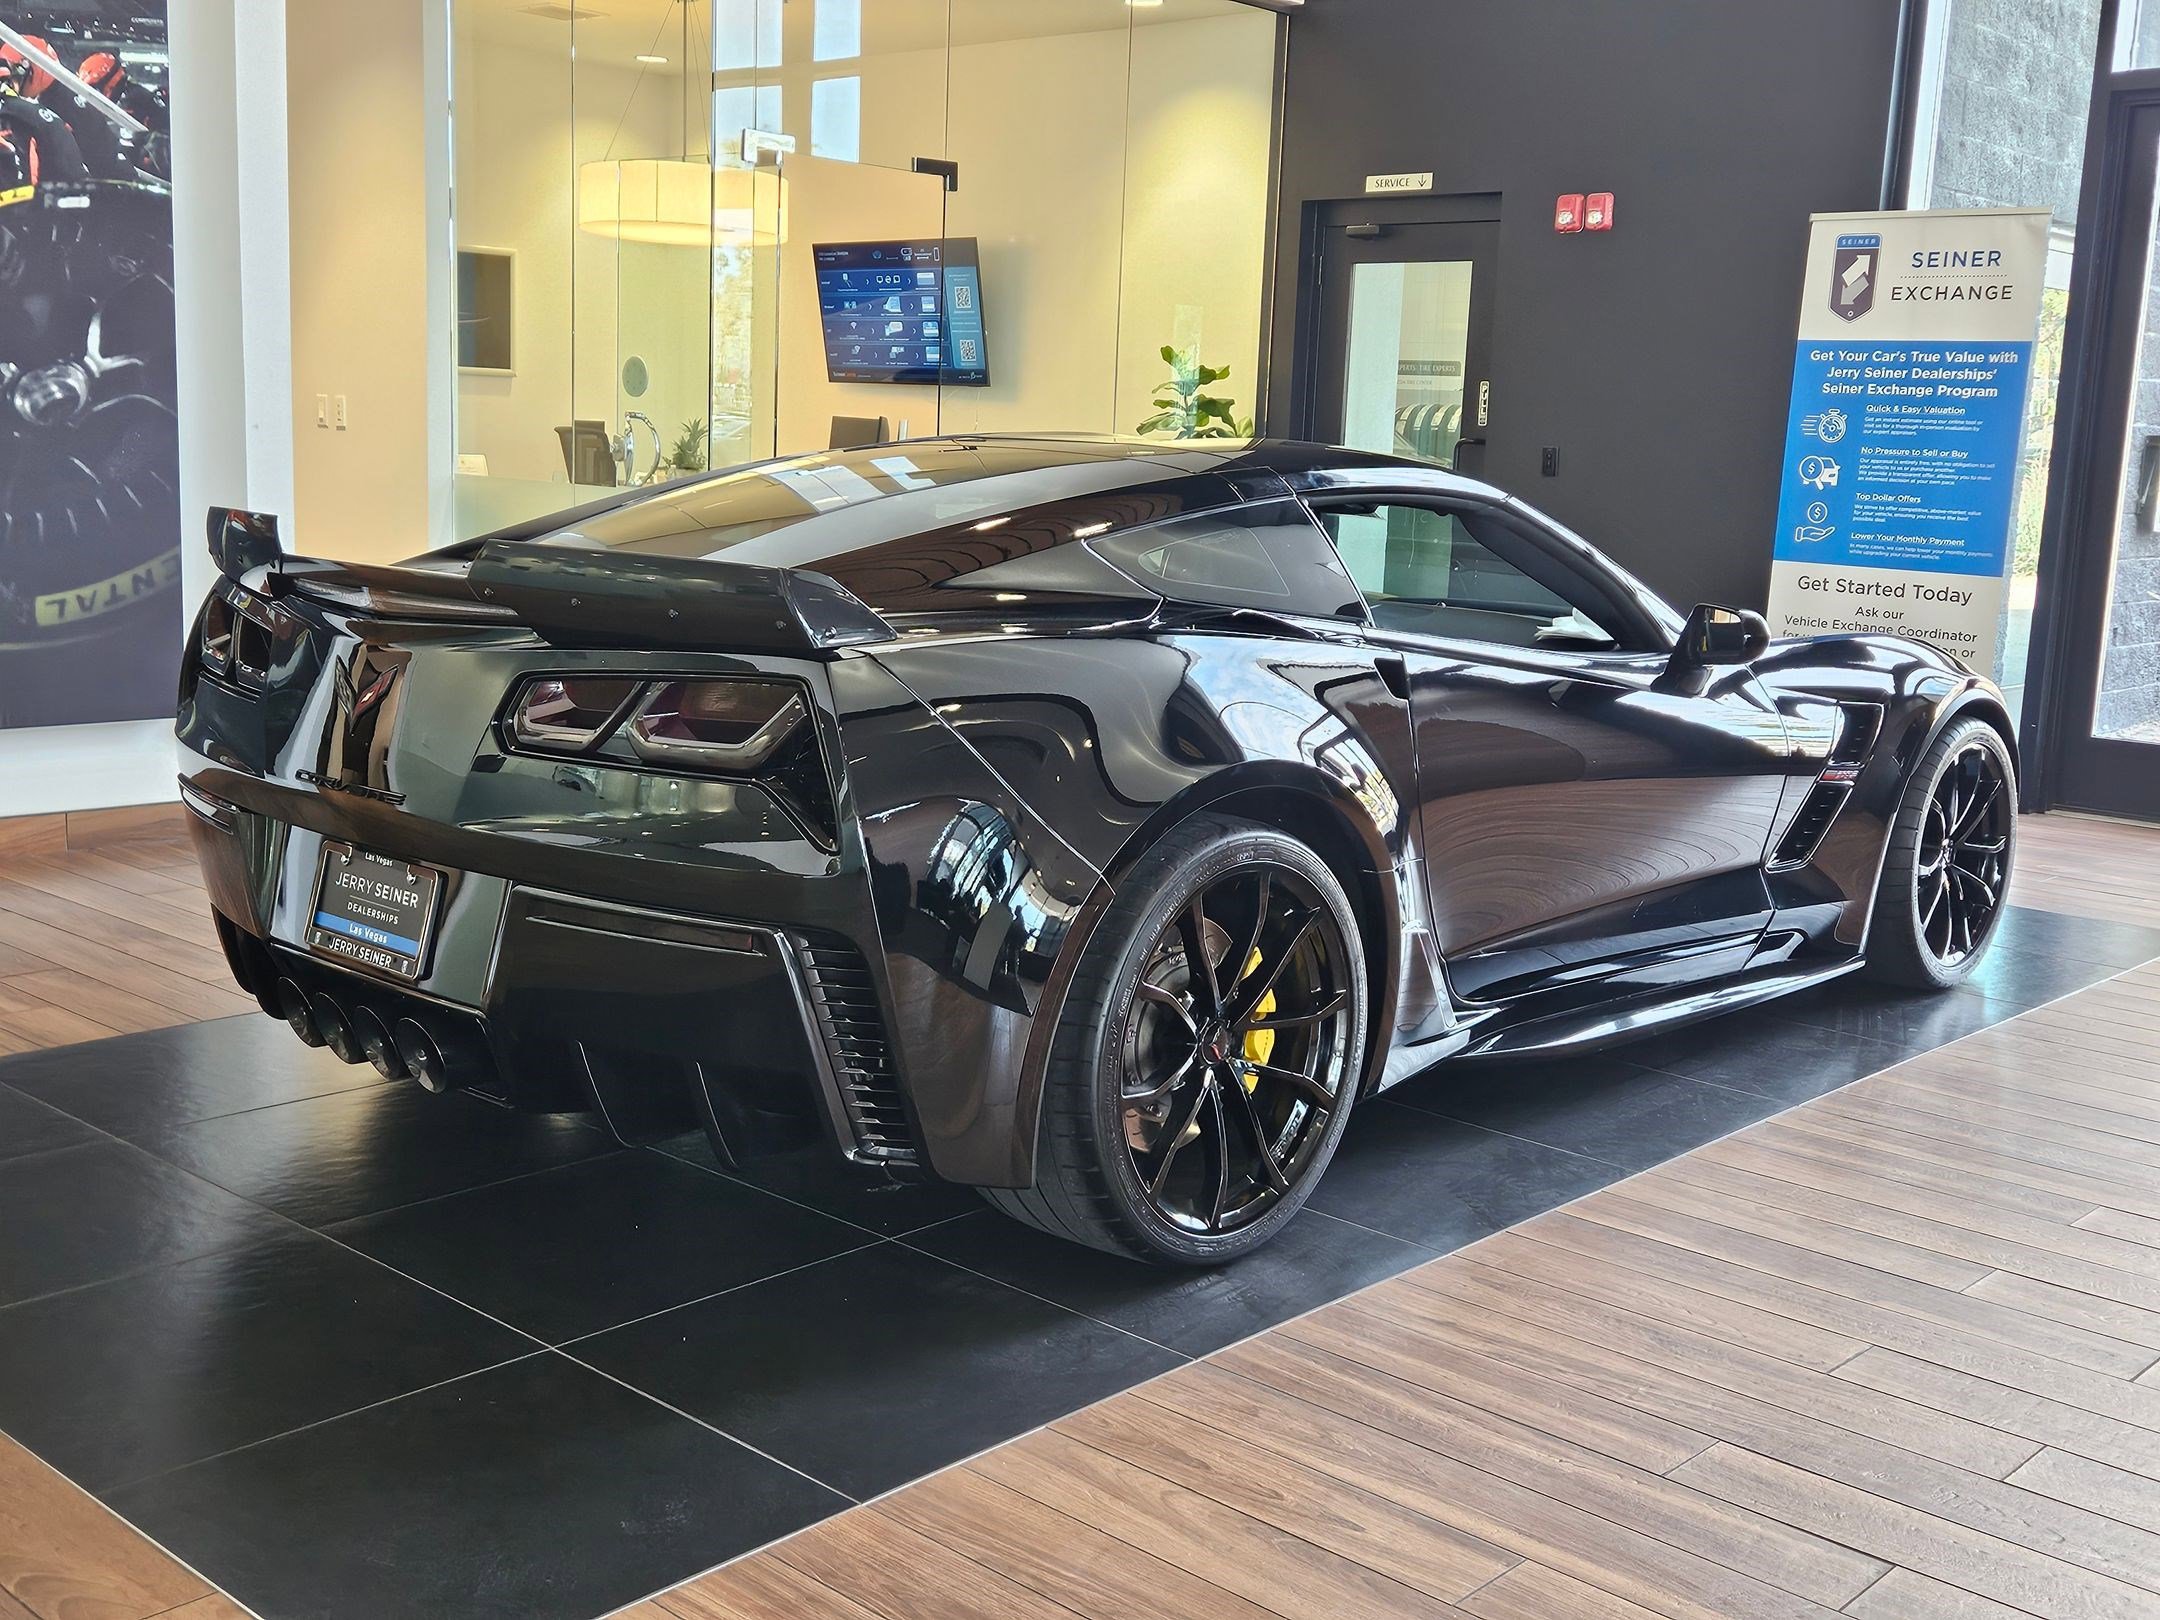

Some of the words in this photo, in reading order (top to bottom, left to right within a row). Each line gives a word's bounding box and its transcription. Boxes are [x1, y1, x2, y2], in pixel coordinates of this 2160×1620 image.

[1374, 177, 1410, 188] SERVICE
[1841, 238, 1876, 246] SEINER
[1911, 250, 2002, 269] SEINER
[1890, 284, 2014, 301] EXCHANGE
[1810, 350, 1834, 362] Get
[1838, 350, 1868, 362] Your
[1872, 350, 1906, 363] Car's
[1910, 351, 1941, 363] True
[1945, 351, 1985, 363] Value
[1988, 352, 2019, 364] with
[1827, 366, 1860, 380] Jerry
[1864, 367, 1908, 379] Seiner
[1822, 382, 1863, 395] Seiner
[1867, 384, 1933, 398] Exchange
[1937, 385, 1998, 399] Program
[1481, 385, 1489, 415] PULL
[1866, 404, 1891, 413] Quick
[1893, 405, 1899, 413] &
[1902, 406, 1922, 415] Easy
[1924, 406, 1966, 415] Valuation
[1861, 446, 1873, 454] No
[1875, 447, 1910, 456] Pressure
[1912, 448, 1921, 456] to
[1923, 449, 1938, 457] Sell
[1951, 450, 1968, 459] Buy
[1856, 492, 1870, 501] Top
[1872, 493, 1896, 501] Dollar
[1897, 494, 1921, 503] Offers
[1851, 532, 1875, 540] Lower
[1876, 533, 1895, 542] Your
[1896, 535, 1928, 545] Monthly
[1929, 537, 1965, 547] Payment
[1797, 575, 1829, 592] Get
[1835, 577, 1905, 598] Started
[1912, 584, 1973, 606] Today
[1855, 606, 1879, 618] Ask
[1882, 609, 1904, 620] our
[1784, 614, 1828, 630] Vehicle
[1832, 619, 1893, 634] Exchange
[1897, 625, 1978, 643] Coordinator
[1961, 649, 1975, 658] or
[365, 851, 375, 862] Las
[376, 855, 393, 867] Vegas
[335, 872, 375, 894] JERRY
[374, 882, 419, 909] SEINER
[347, 901, 399, 925] DEALERSHIPS
[349, 923, 362, 936] Las
[364, 928, 388, 944] Vegas
[328, 937, 360, 957] JERRY
[358, 946, 392, 968] SEINER
